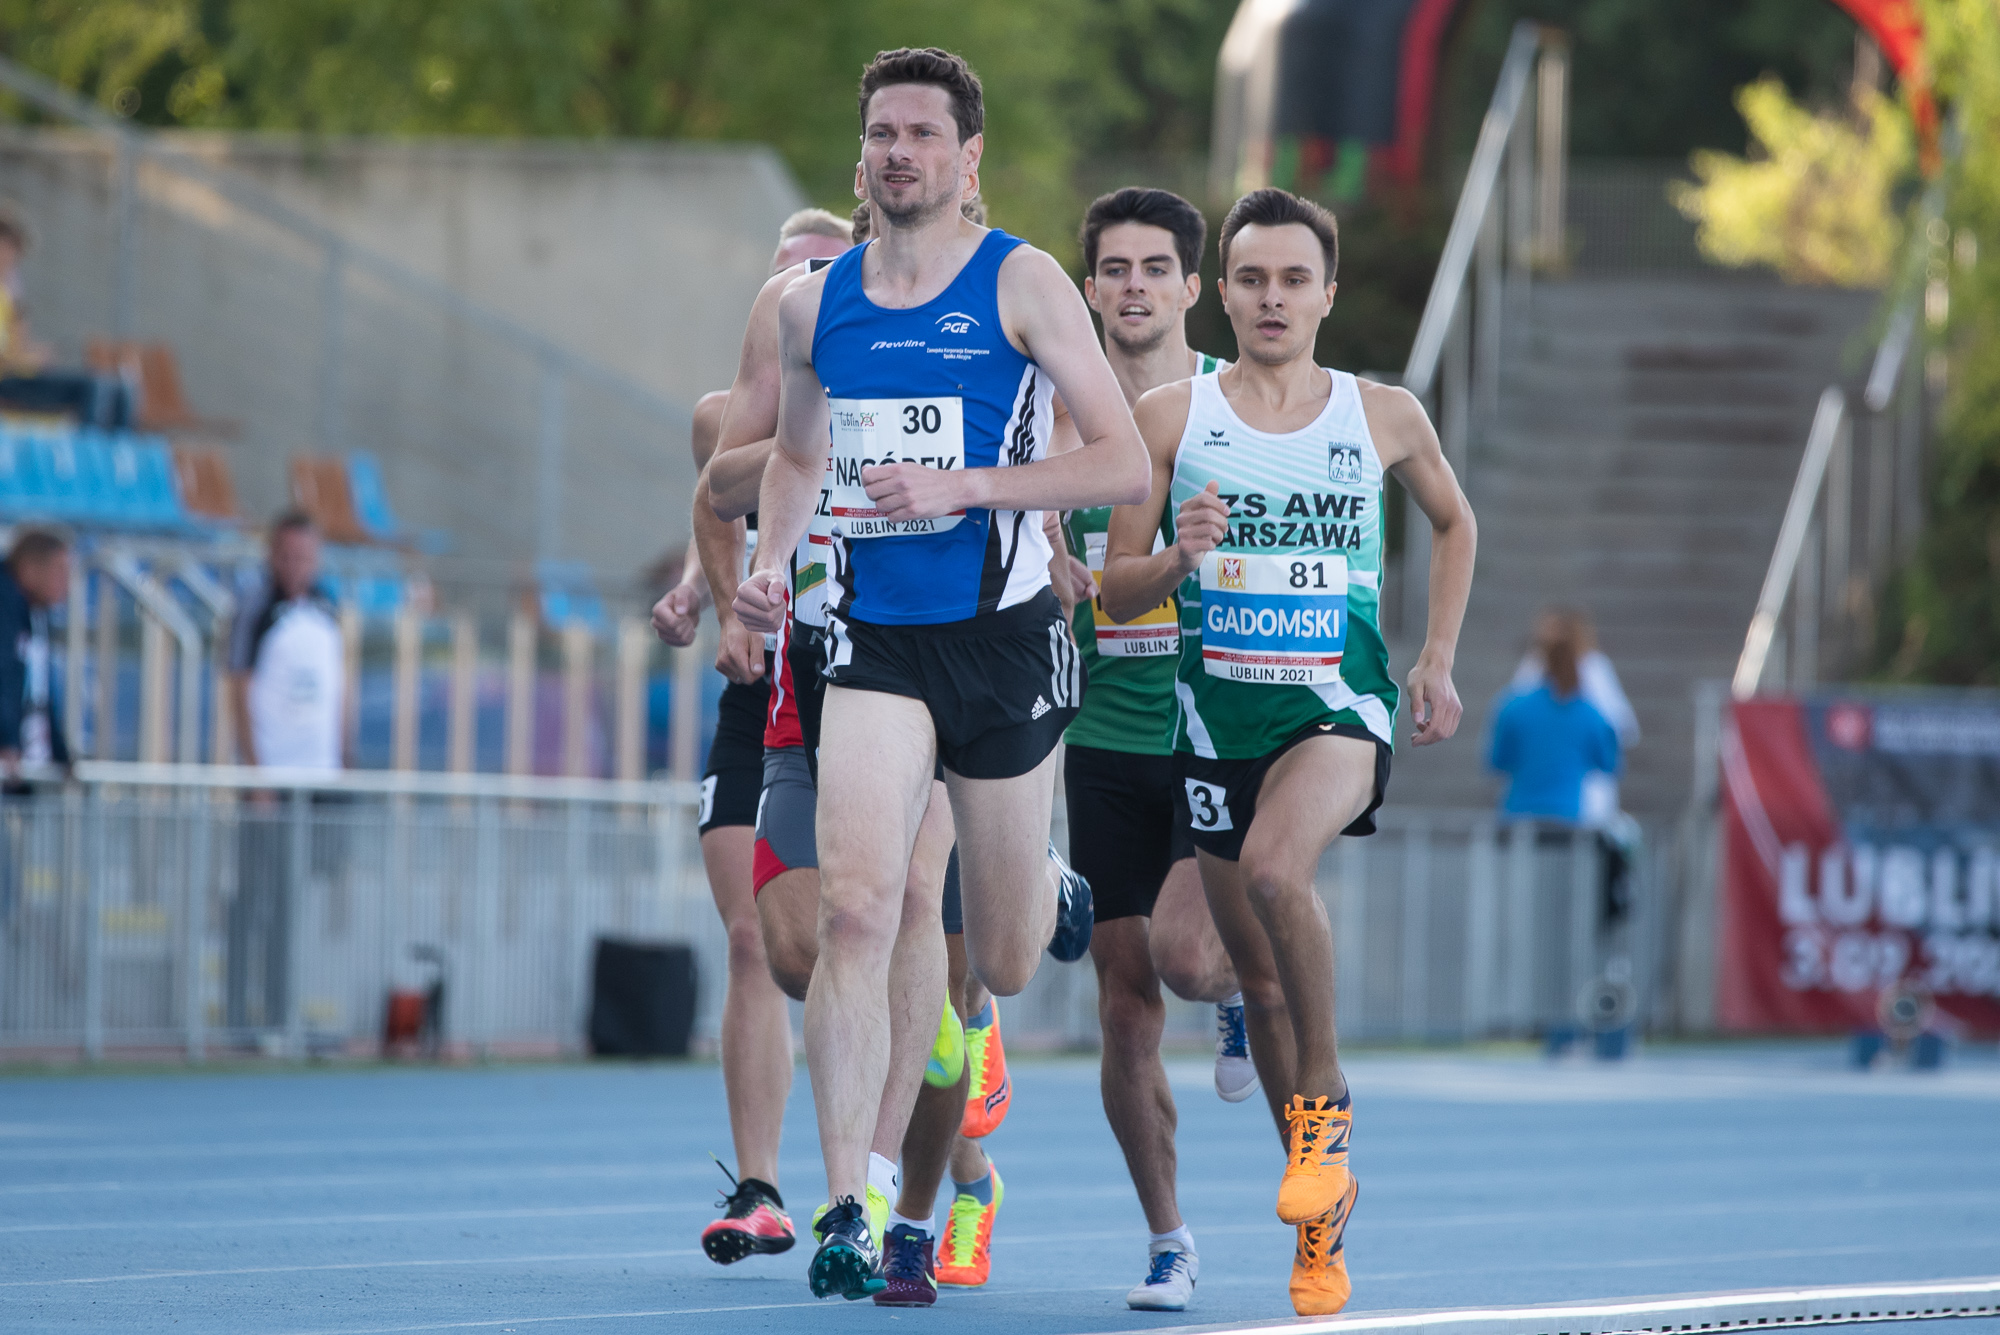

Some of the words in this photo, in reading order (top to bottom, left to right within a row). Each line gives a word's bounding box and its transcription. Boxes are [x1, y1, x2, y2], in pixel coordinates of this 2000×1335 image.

[941, 322, 970, 334] PGE
[902, 404, 942, 435] 30
[1203, 439, 1230, 447] erima
[1216, 493, 1267, 518] ZS
[1283, 493, 1366, 520] AWF
[850, 520, 897, 535] LUBLIN
[902, 519, 936, 532] 2021
[1216, 522, 1361, 551] ARSZAWA
[1289, 561, 1328, 589] 81
[1207, 604, 1340, 639] GADOMSKI
[1124, 640, 1169, 654] LUBLIN
[1229, 665, 1275, 682] LUBLIN
[1280, 668, 1314, 682] 2021
[1192, 784, 1220, 828] 3
[1777, 842, 2000, 929] LUBLI
